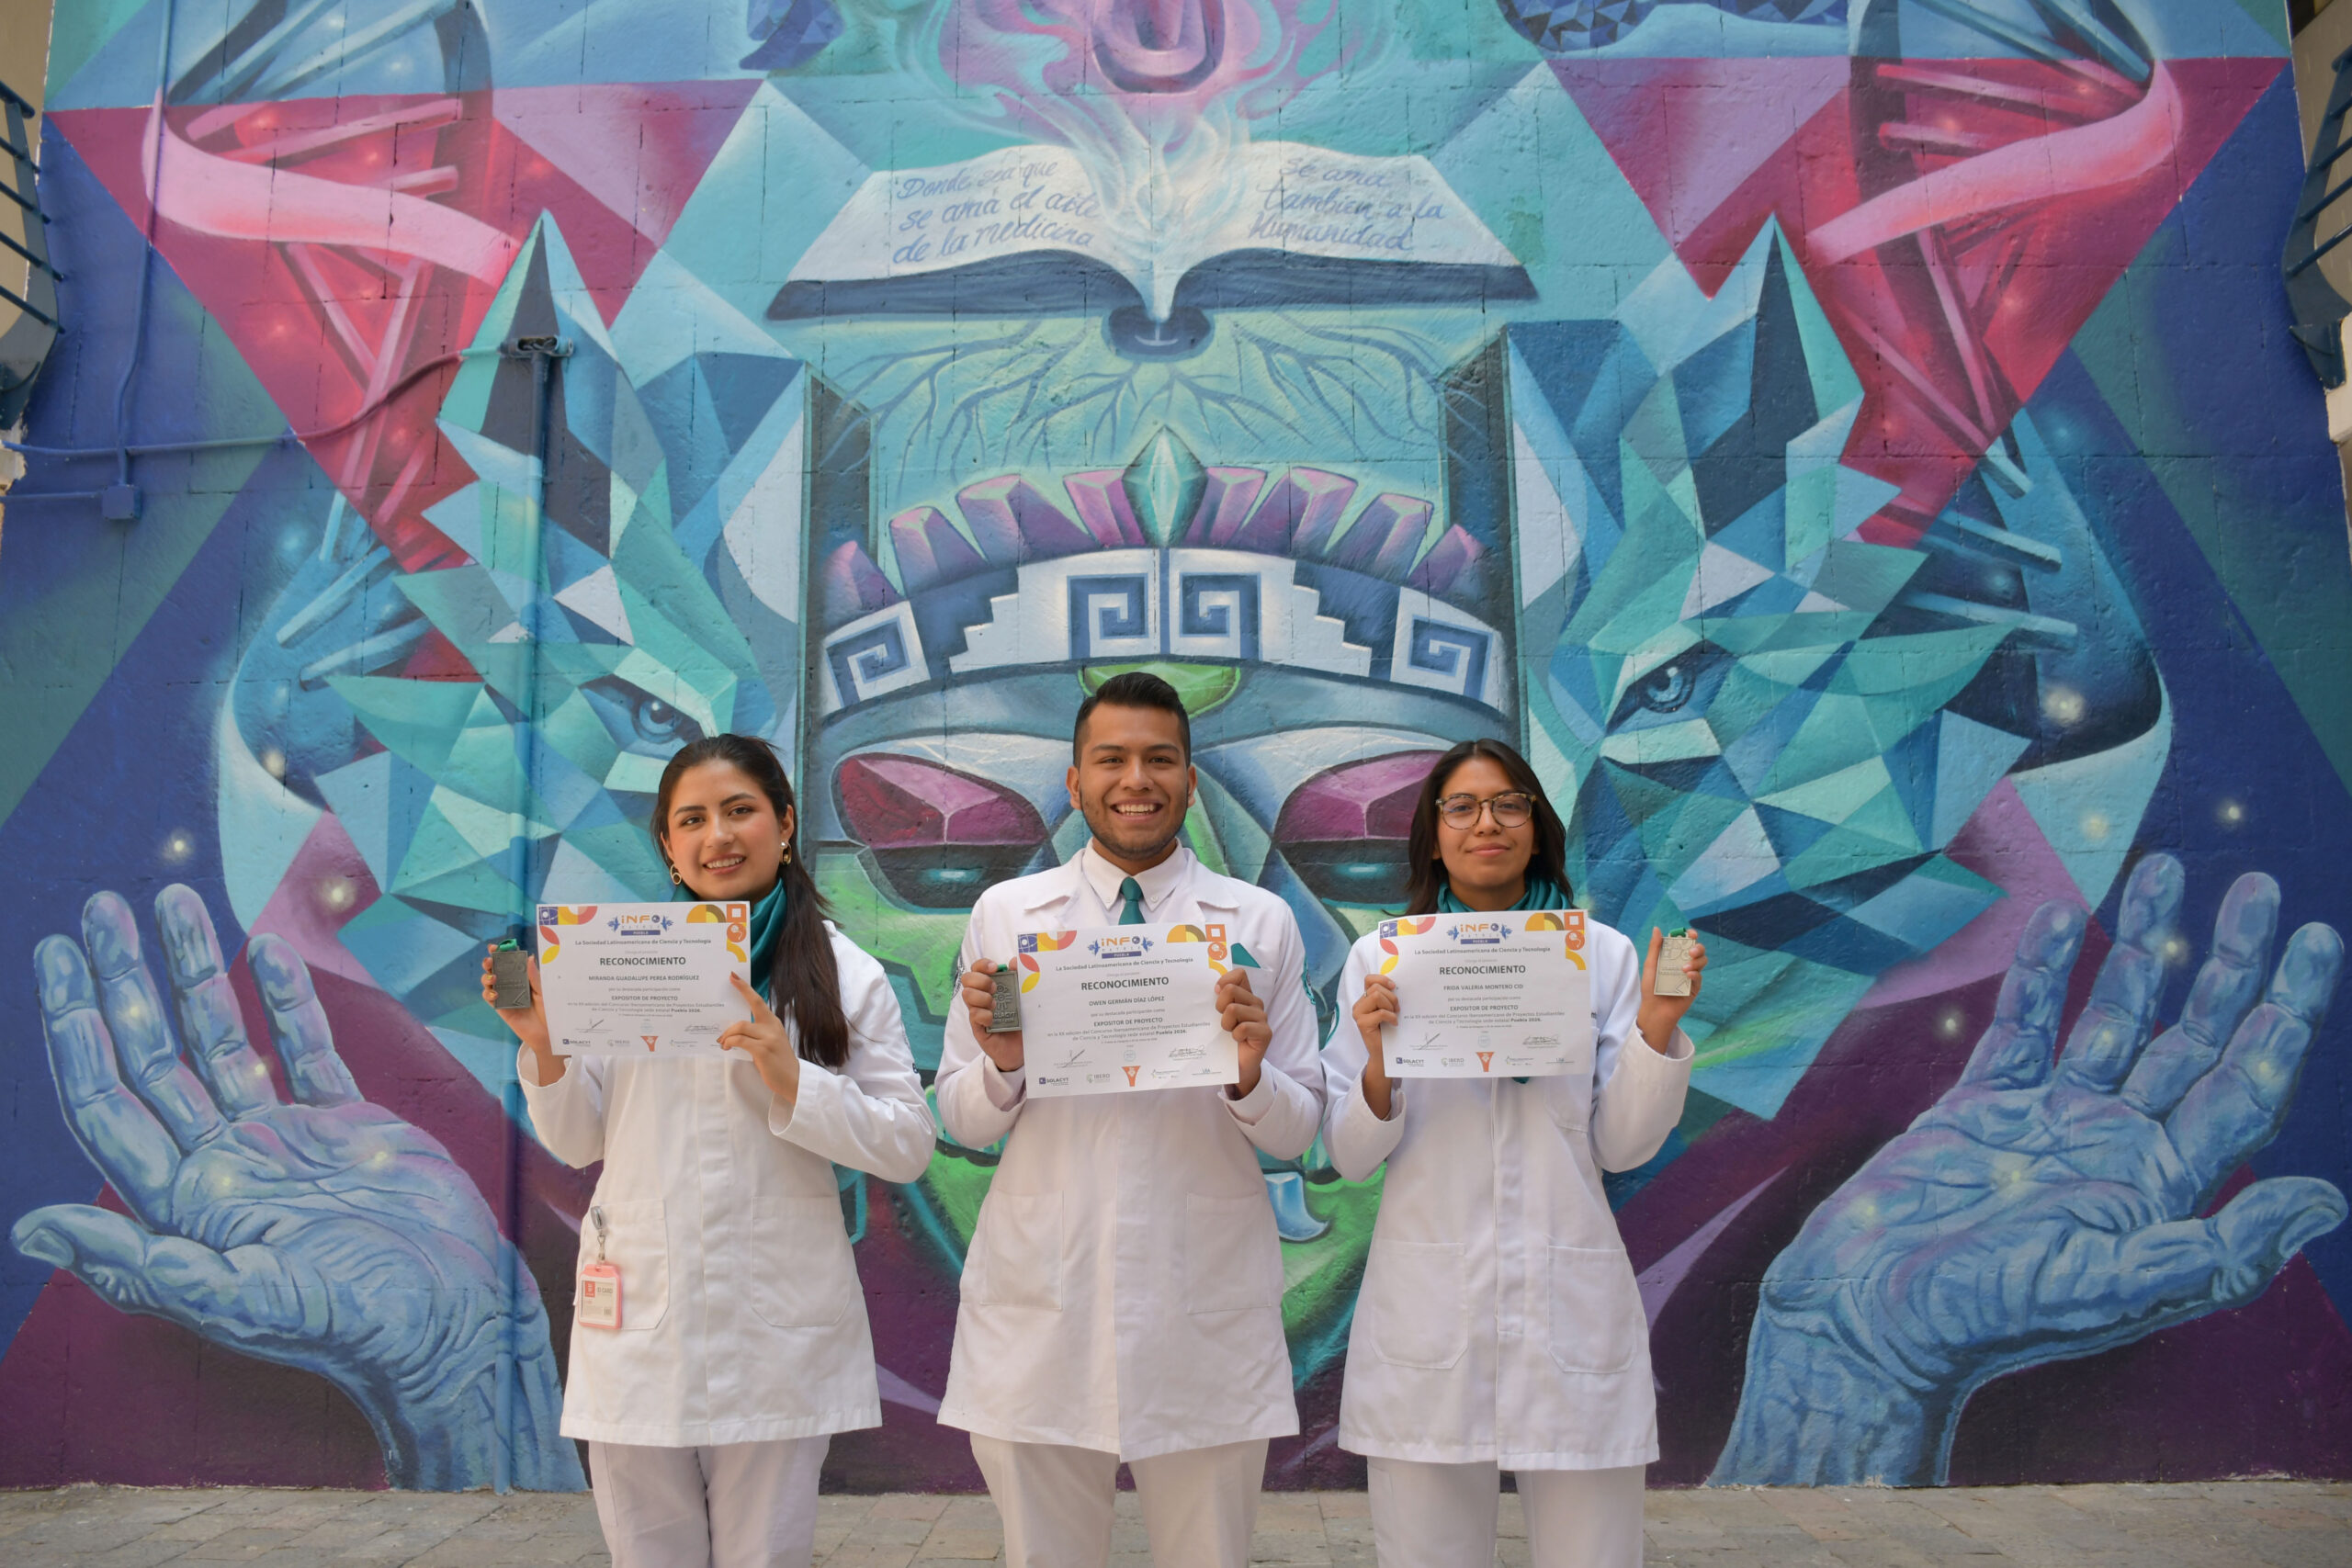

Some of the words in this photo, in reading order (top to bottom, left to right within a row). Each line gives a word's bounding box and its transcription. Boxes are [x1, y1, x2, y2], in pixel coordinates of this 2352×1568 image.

[898, 166, 970, 199] Donde
[978, 168, 1012, 187] sea
[1023, 162, 1057, 187] que
[1323, 168, 1391, 187] ama
[900, 210, 932, 231] se
[1011, 185, 1045, 210] el
[1387, 205, 1402, 218] a
[1413, 193, 1446, 220] la
[893, 234, 931, 265] de
[939, 228, 969, 257] la
[975, 213, 1095, 247] medicina
[600, 957, 686, 965] RECONOCIMIENTO
[1440, 965, 1526, 975] RECONOCIMIENTO
[1081, 976, 1169, 990] RECONOCIMIENTO
